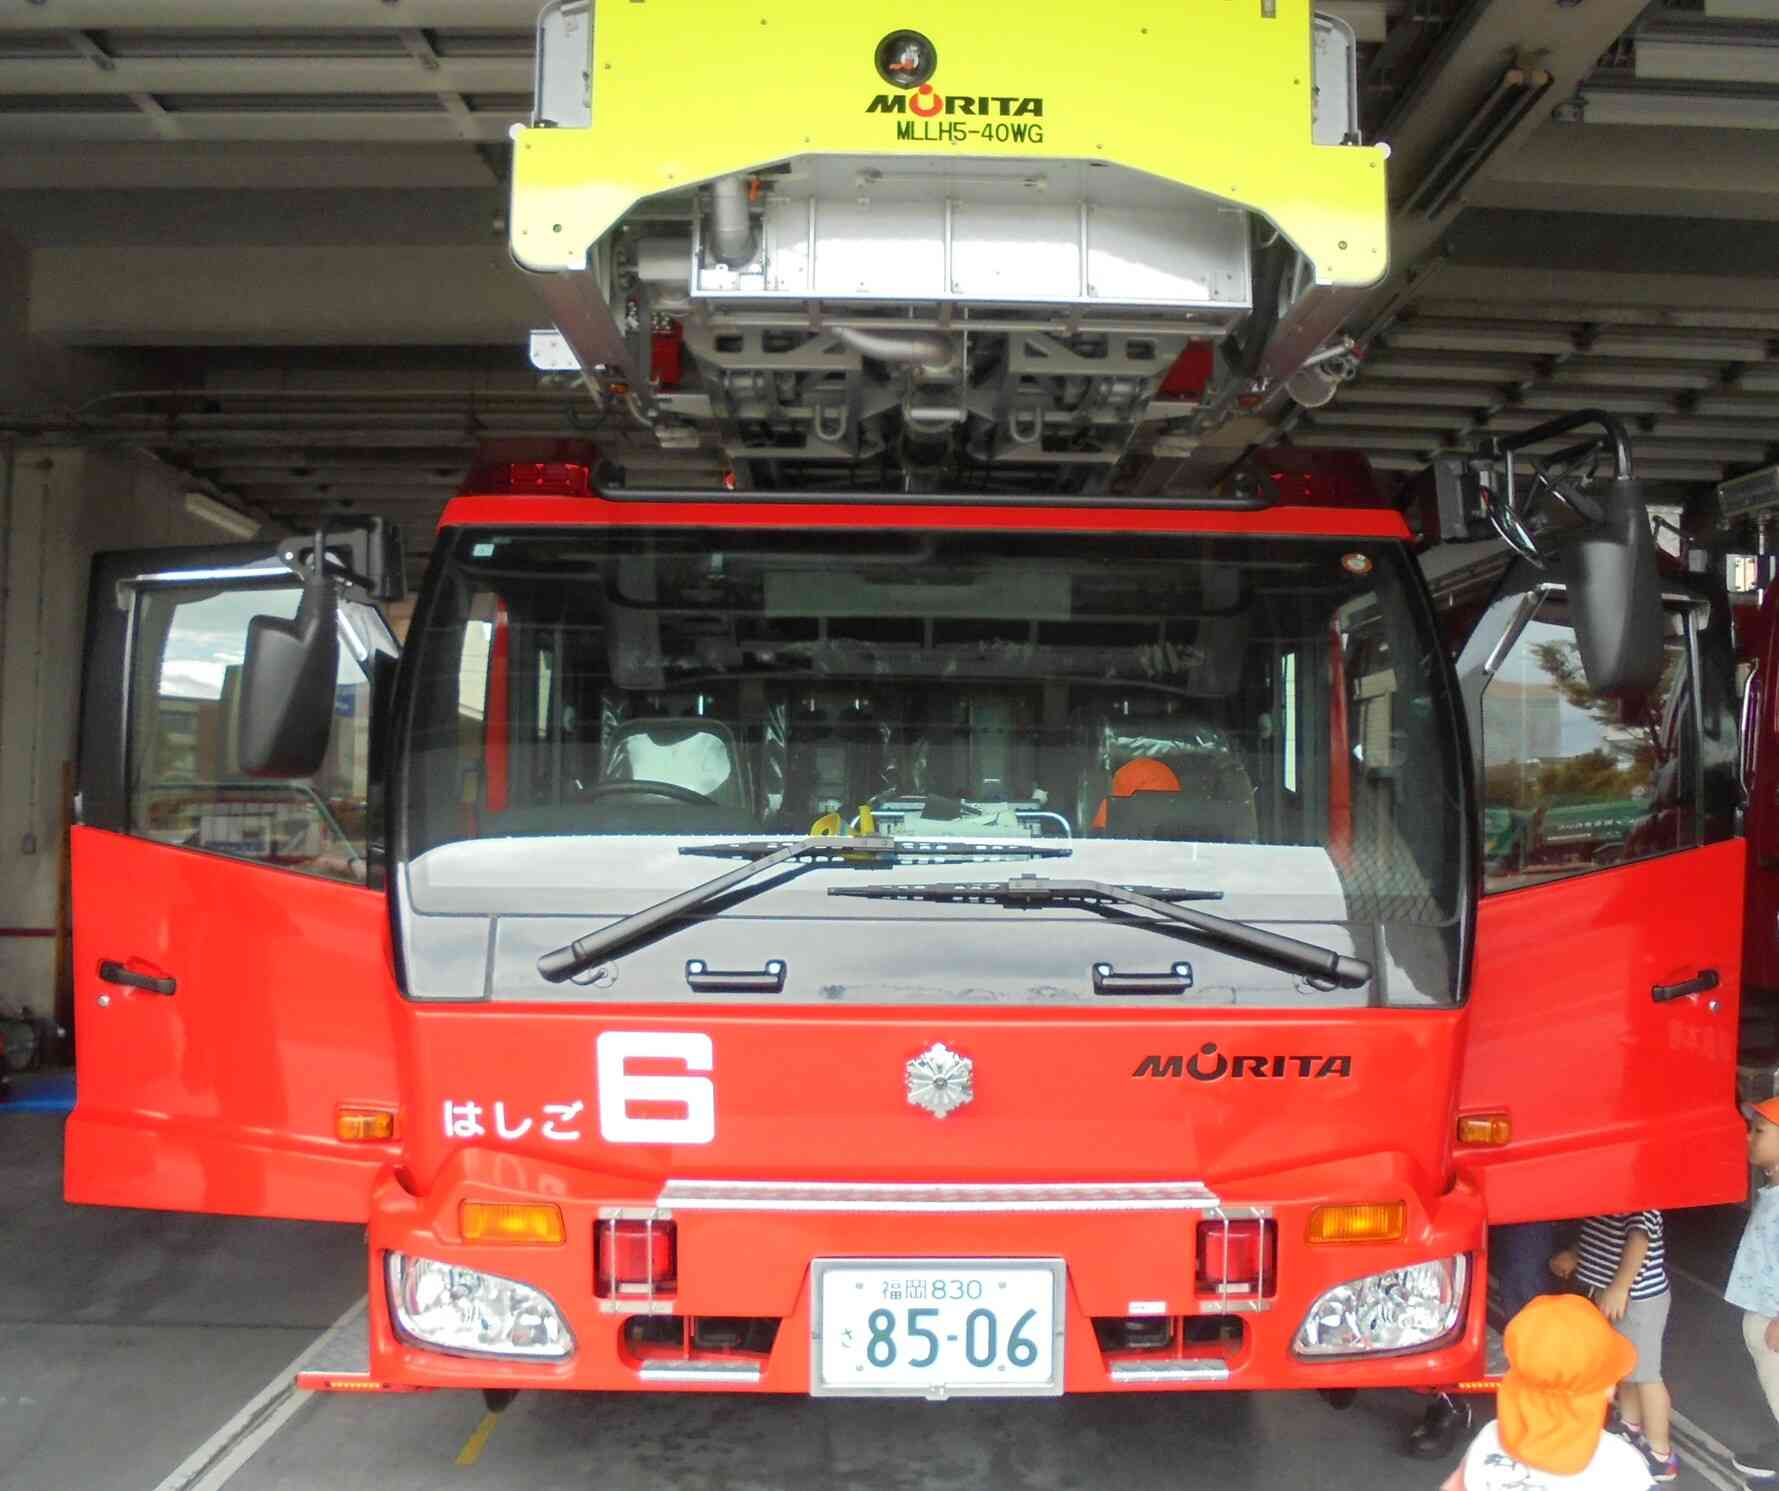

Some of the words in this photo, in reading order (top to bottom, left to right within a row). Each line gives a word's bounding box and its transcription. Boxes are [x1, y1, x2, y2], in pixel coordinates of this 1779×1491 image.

[865, 84, 1043, 117] MORITA
[896, 120, 1043, 143] MLLH5-40WG
[1132, 1042, 1351, 1081] MORITA
[443, 1099, 584, 1140] はしご
[596, 1031, 715, 1144] 6
[866, 1307, 1038, 1369] 85-06
